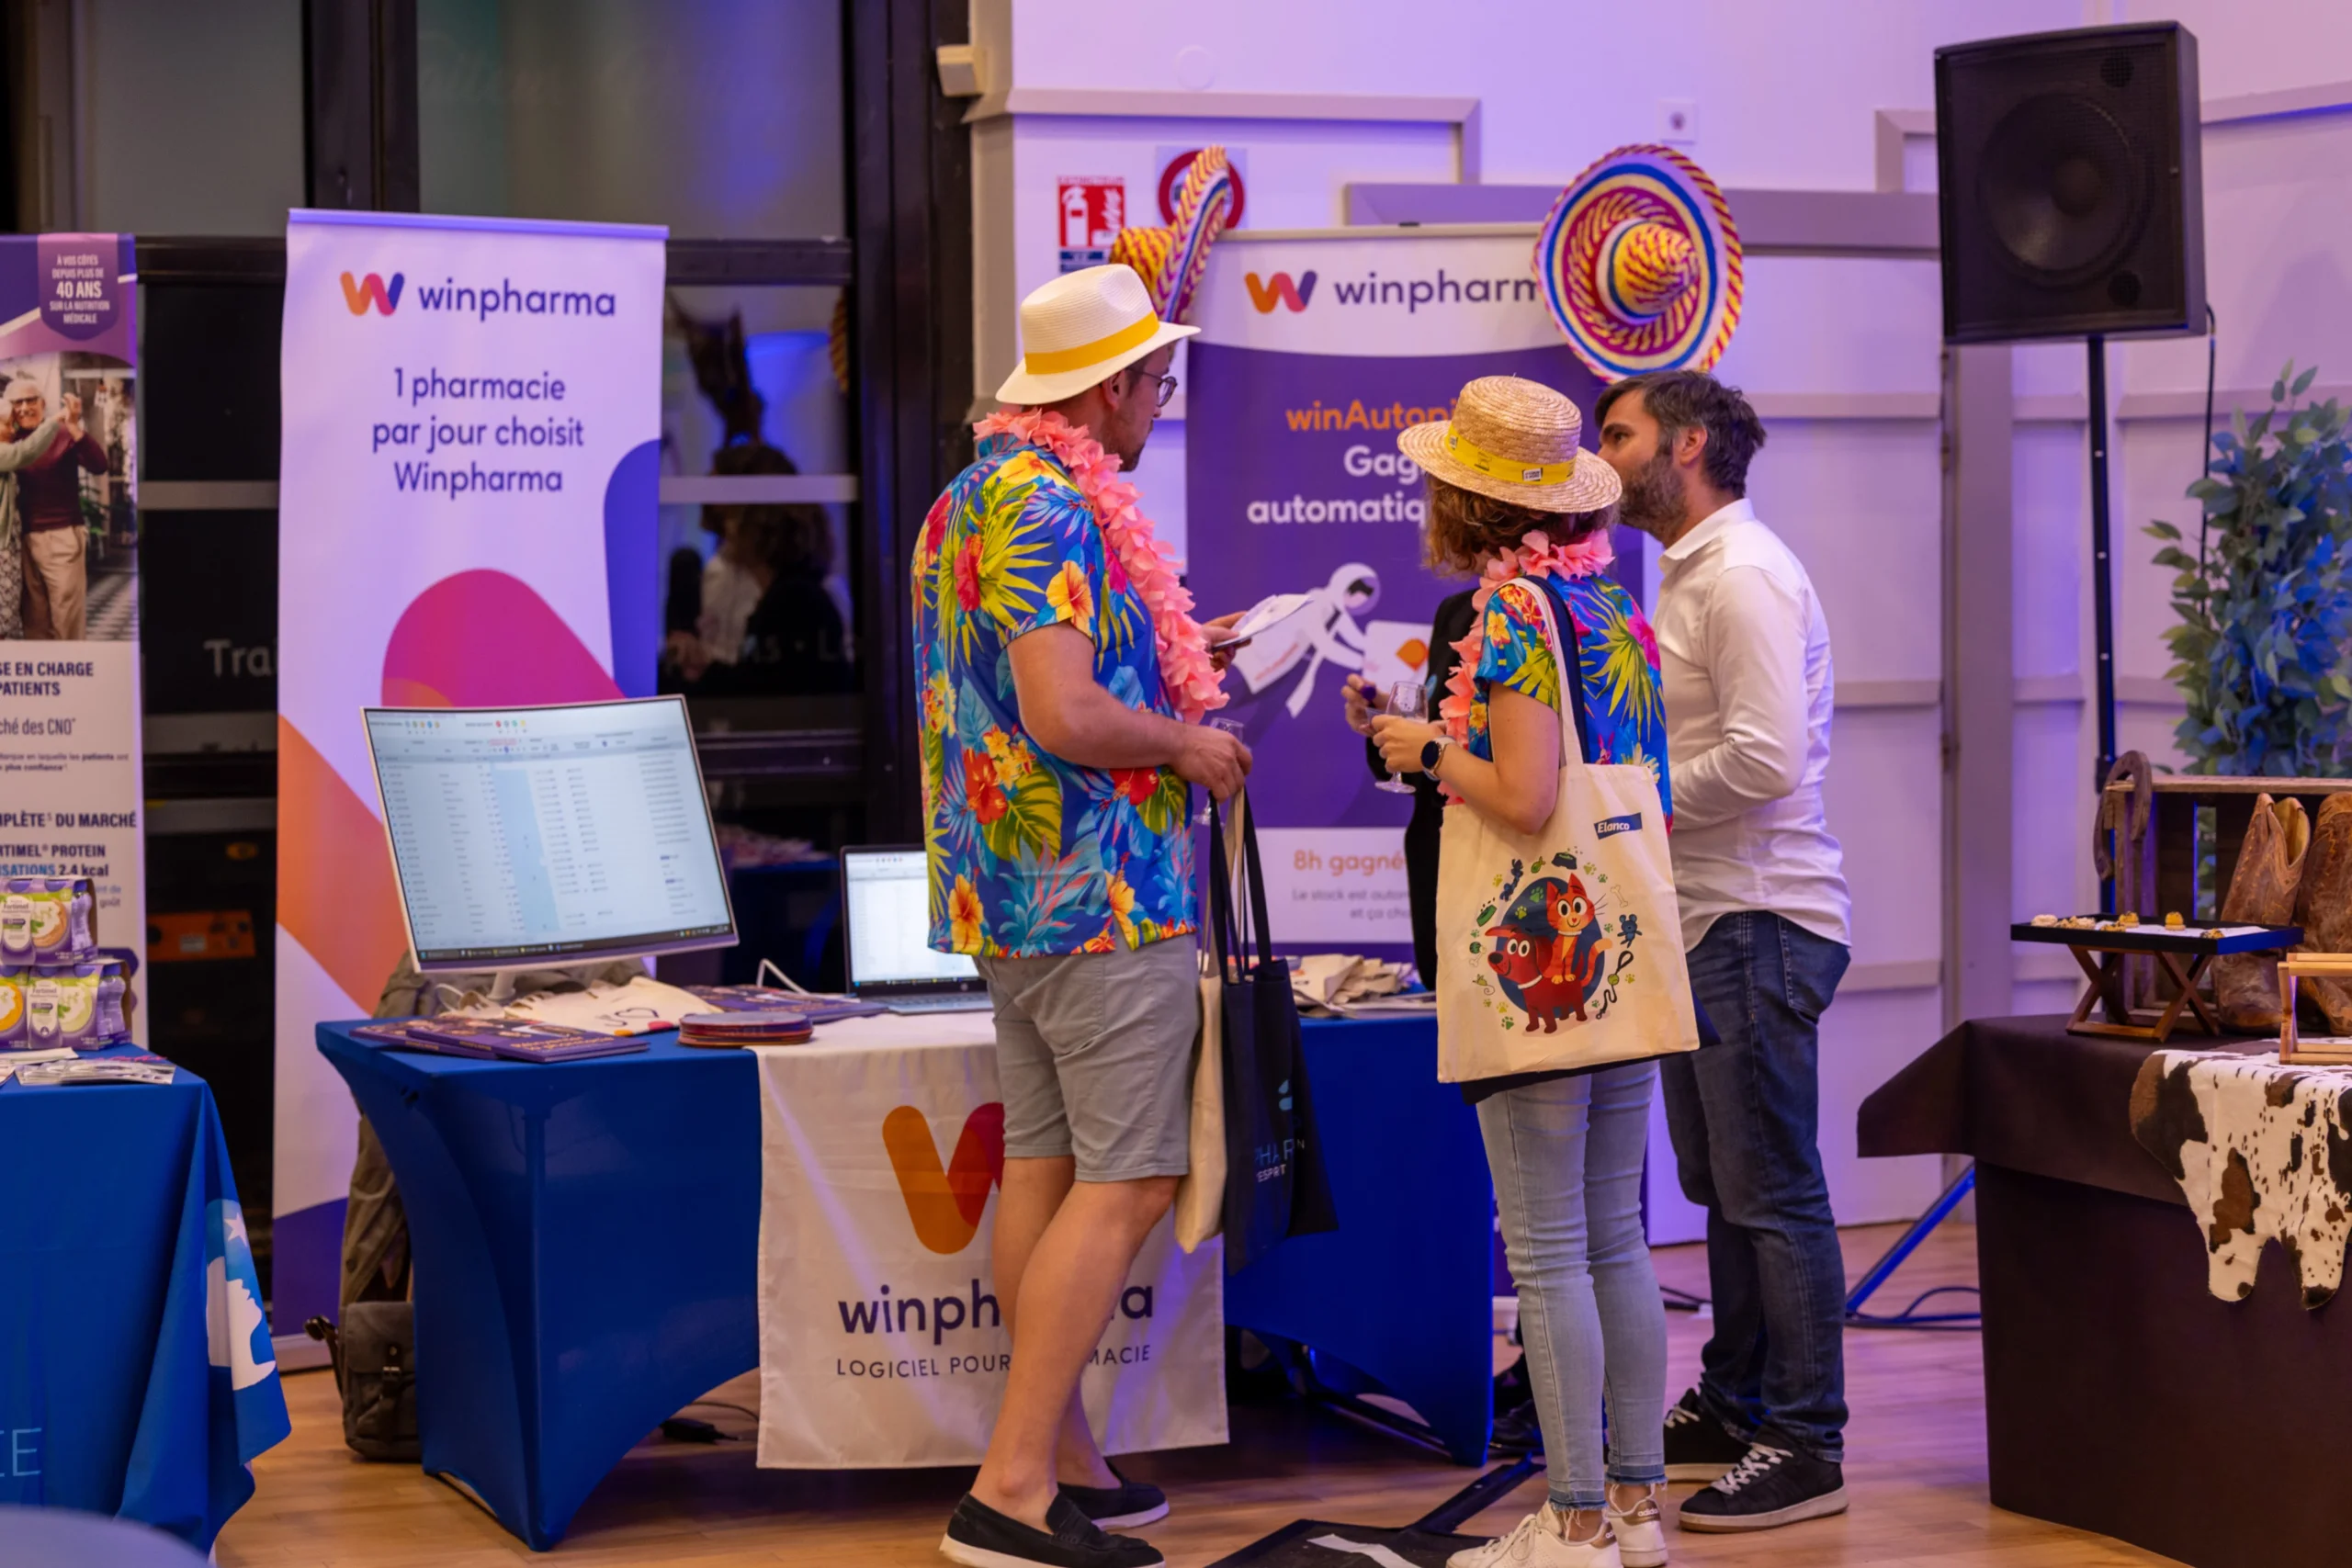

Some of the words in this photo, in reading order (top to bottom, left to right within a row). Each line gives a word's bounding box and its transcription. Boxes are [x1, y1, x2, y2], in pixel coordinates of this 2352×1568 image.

[56, 281, 74, 299] 40
[75, 280, 102, 299] ANS
[418, 277, 616, 321] winpharma
[1334, 269, 1536, 313] winpharm
[393, 367, 403, 397] 1
[413, 367, 566, 407] pharmacie
[372, 423, 421, 454] par
[426, 415, 488, 454] jour
[495, 415, 584, 446] choisit
[1343, 445, 1427, 485] Gag
[393, 461, 562, 501] Winpharma
[16, 661, 33, 676] EN
[38, 661, 94, 676] CHARGE
[203, 638, 277, 678] Tra
[22, 719, 44, 735] des
[5, 763, 22, 772] plus
[82, 752, 114, 761] patients
[56, 813, 74, 828] DU
[79, 809, 136, 828] MARCHÉ
[1598, 821, 1630, 834] Elanco
[51, 844, 106, 857] PROTEIN
[1294, 850, 1323, 871] 8h
[1329, 851, 1407, 877] gagné
[82, 863, 108, 876] kcal
[838, 1279, 1153, 1347] winpha
[837, 1358, 940, 1379] LOGICIEL
[950, 1354, 1011, 1374] POUR
[1087, 1345, 1151, 1367] MACIE
